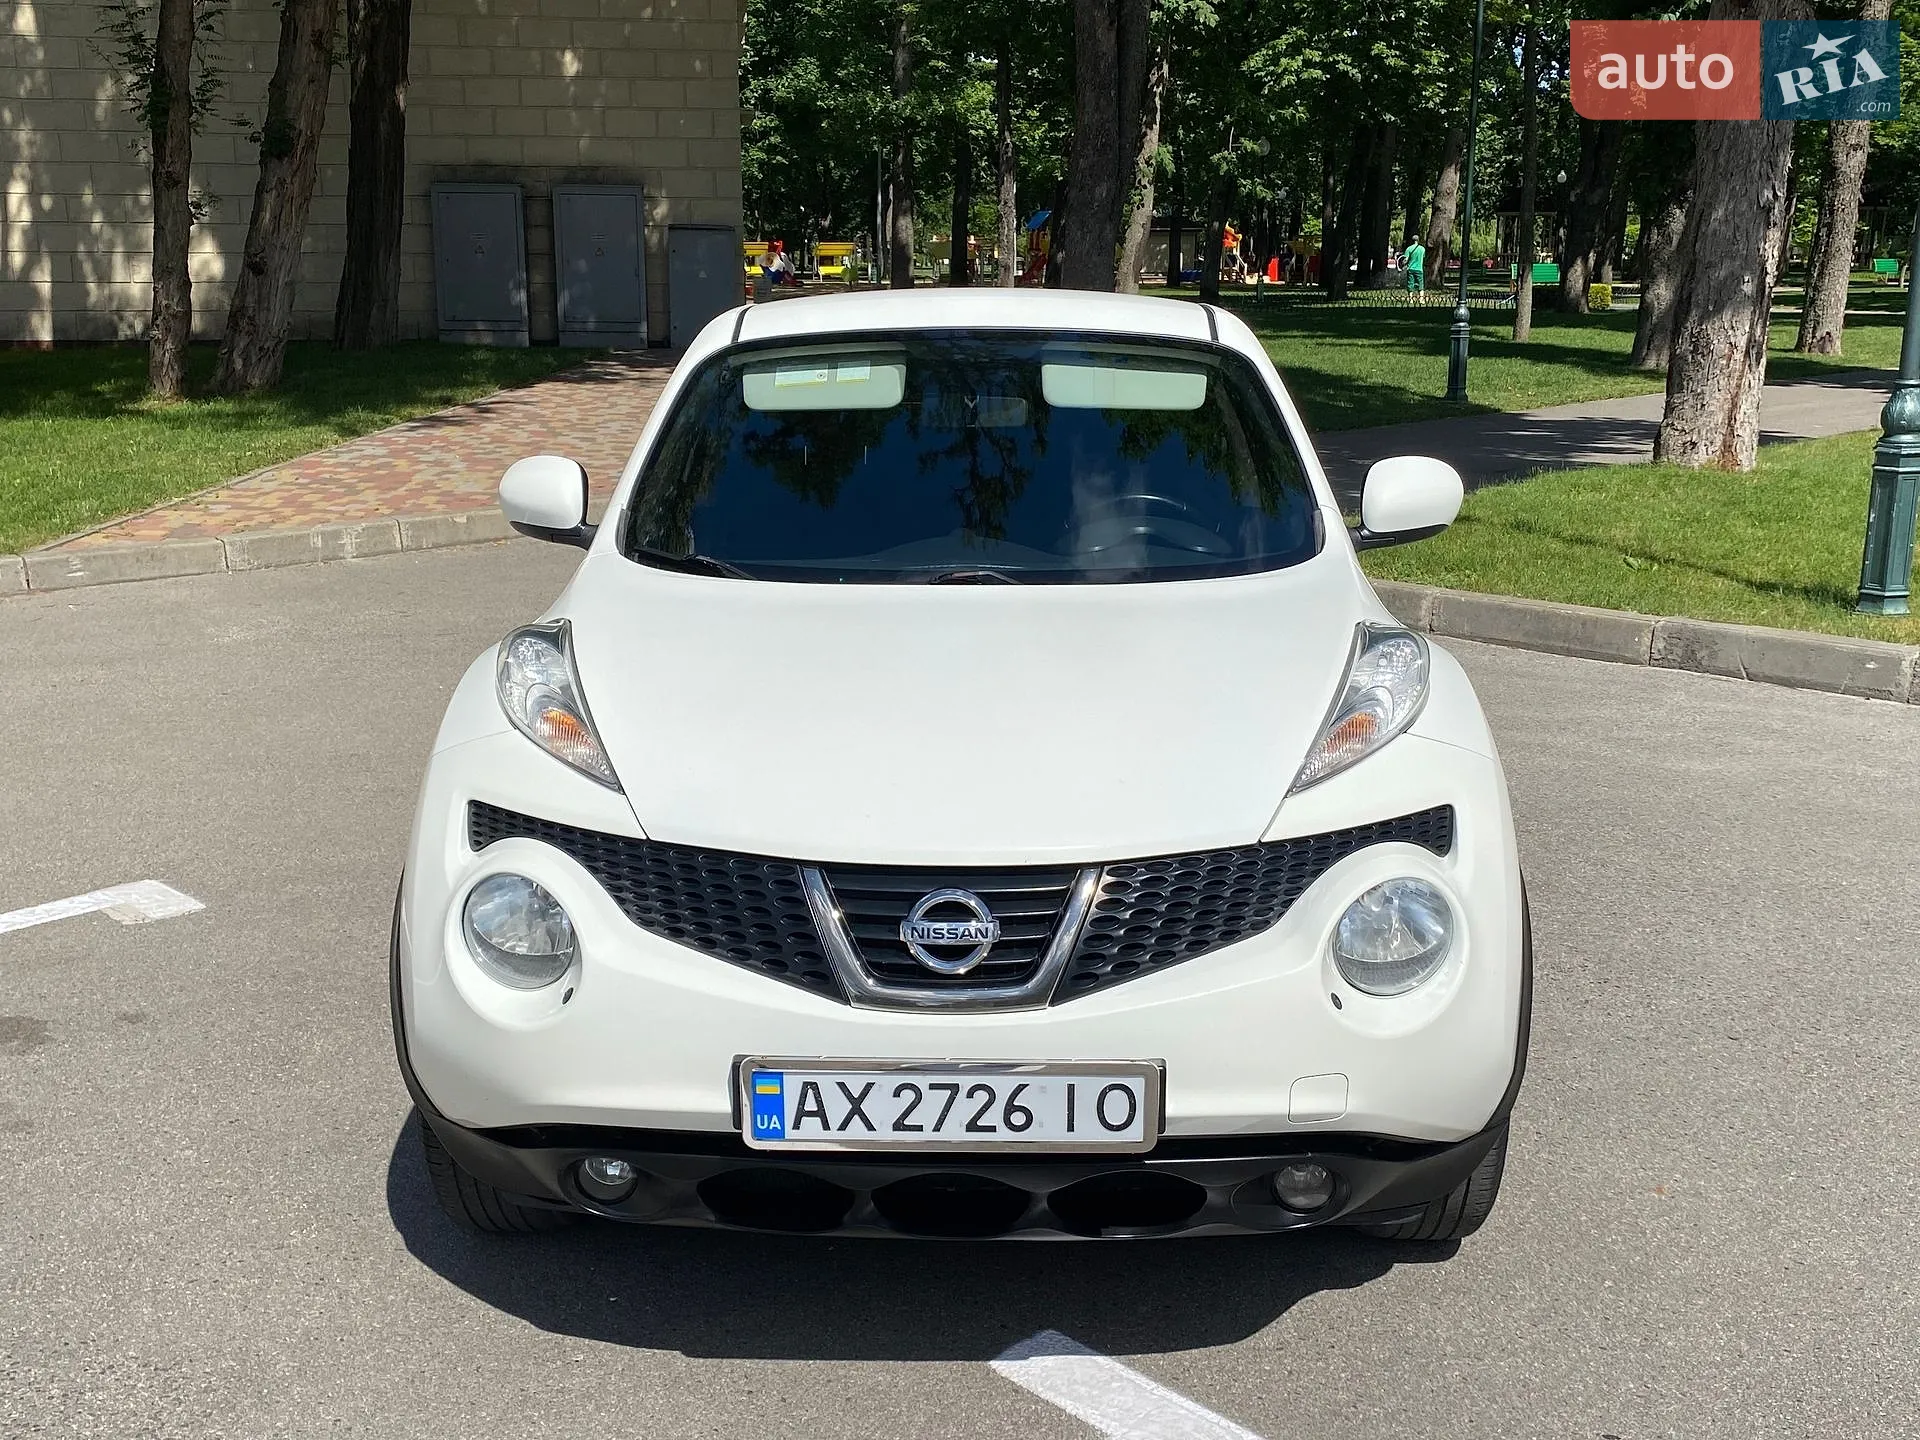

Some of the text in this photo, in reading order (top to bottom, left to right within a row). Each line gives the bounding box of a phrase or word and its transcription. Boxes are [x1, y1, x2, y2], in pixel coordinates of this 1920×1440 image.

[910, 926, 989, 940] NISSAN
[792, 1081, 1137, 1133] AX 2726 IO
[757, 1113, 782, 1130] UA
